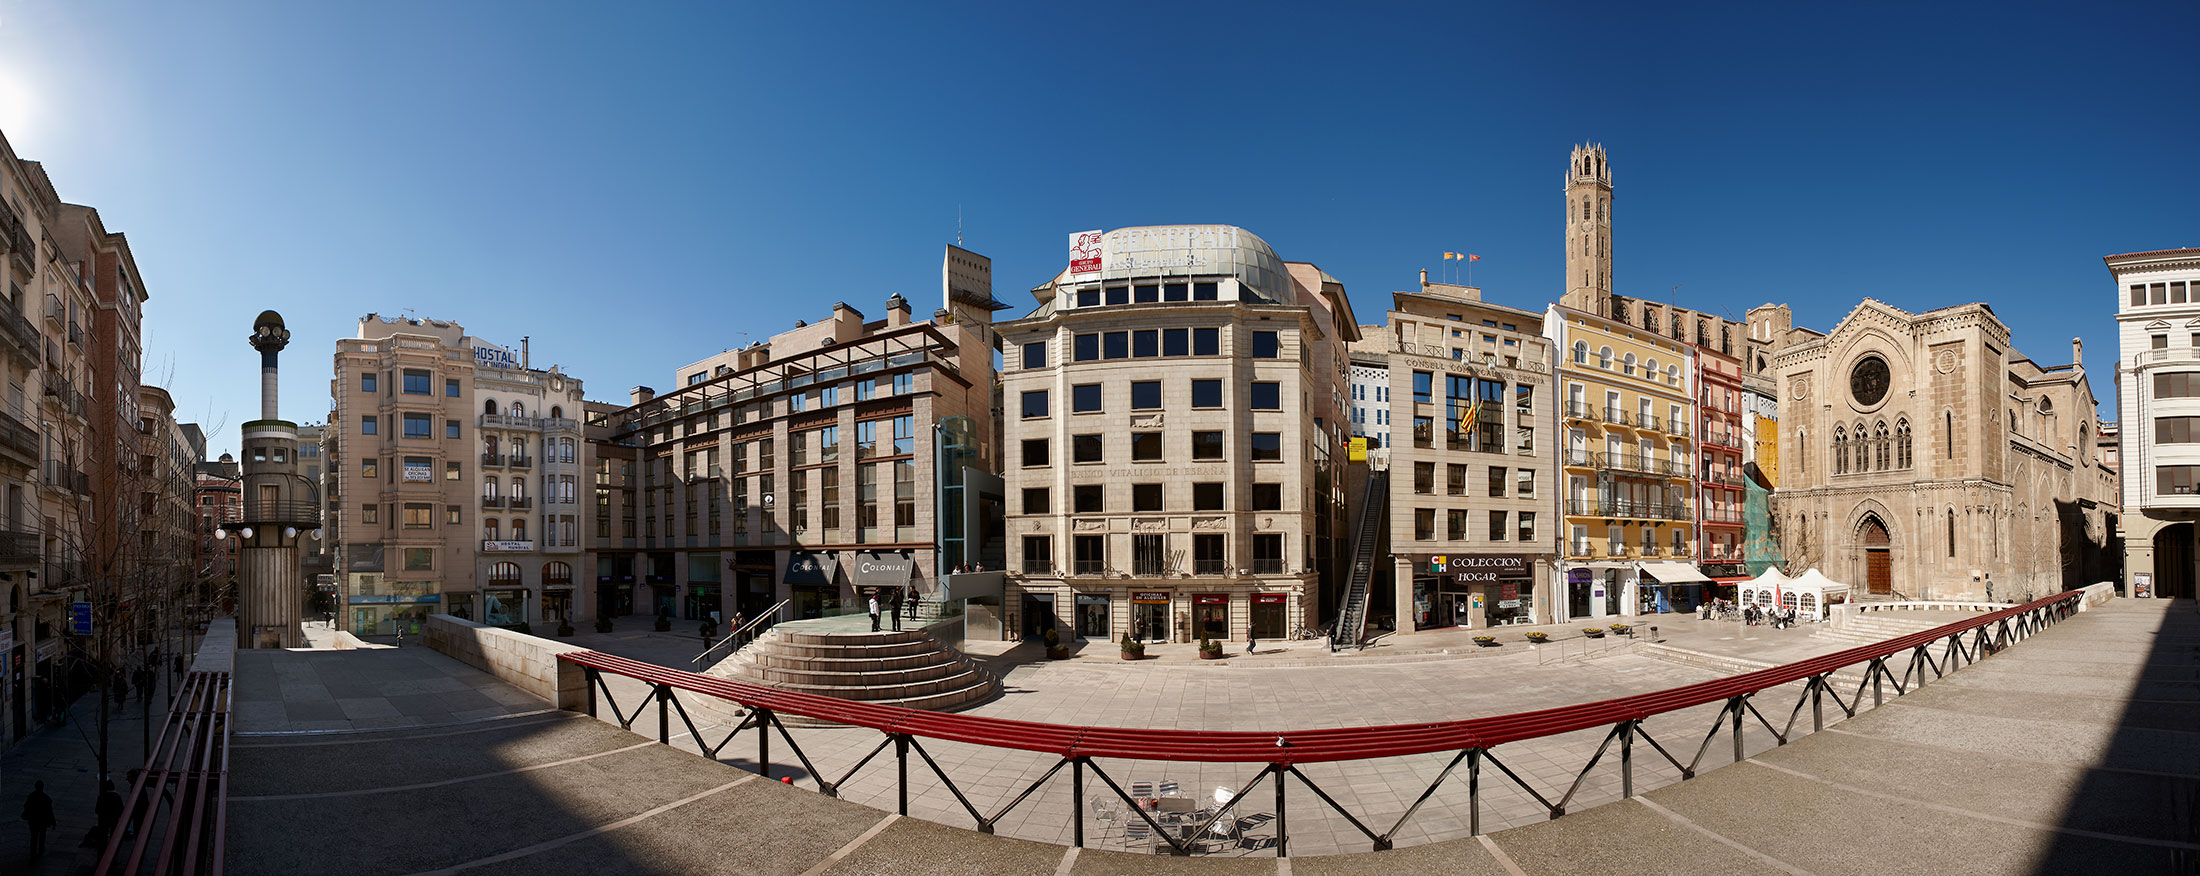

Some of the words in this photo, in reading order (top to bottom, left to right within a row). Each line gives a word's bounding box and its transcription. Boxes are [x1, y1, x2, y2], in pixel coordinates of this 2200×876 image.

[1108, 227, 1239, 255] GENERALI
[1071, 263, 1102, 273] GENERALI
[473, 346, 515, 363] HOSTAL
[1405, 359, 1445, 370] CONSELL
[1166, 468, 1178, 476] DE
[861, 562, 905, 573] COLONIAL
[1452, 558, 1522, 567] COLECCION
[1458, 573, 1497, 582] HOGAR
